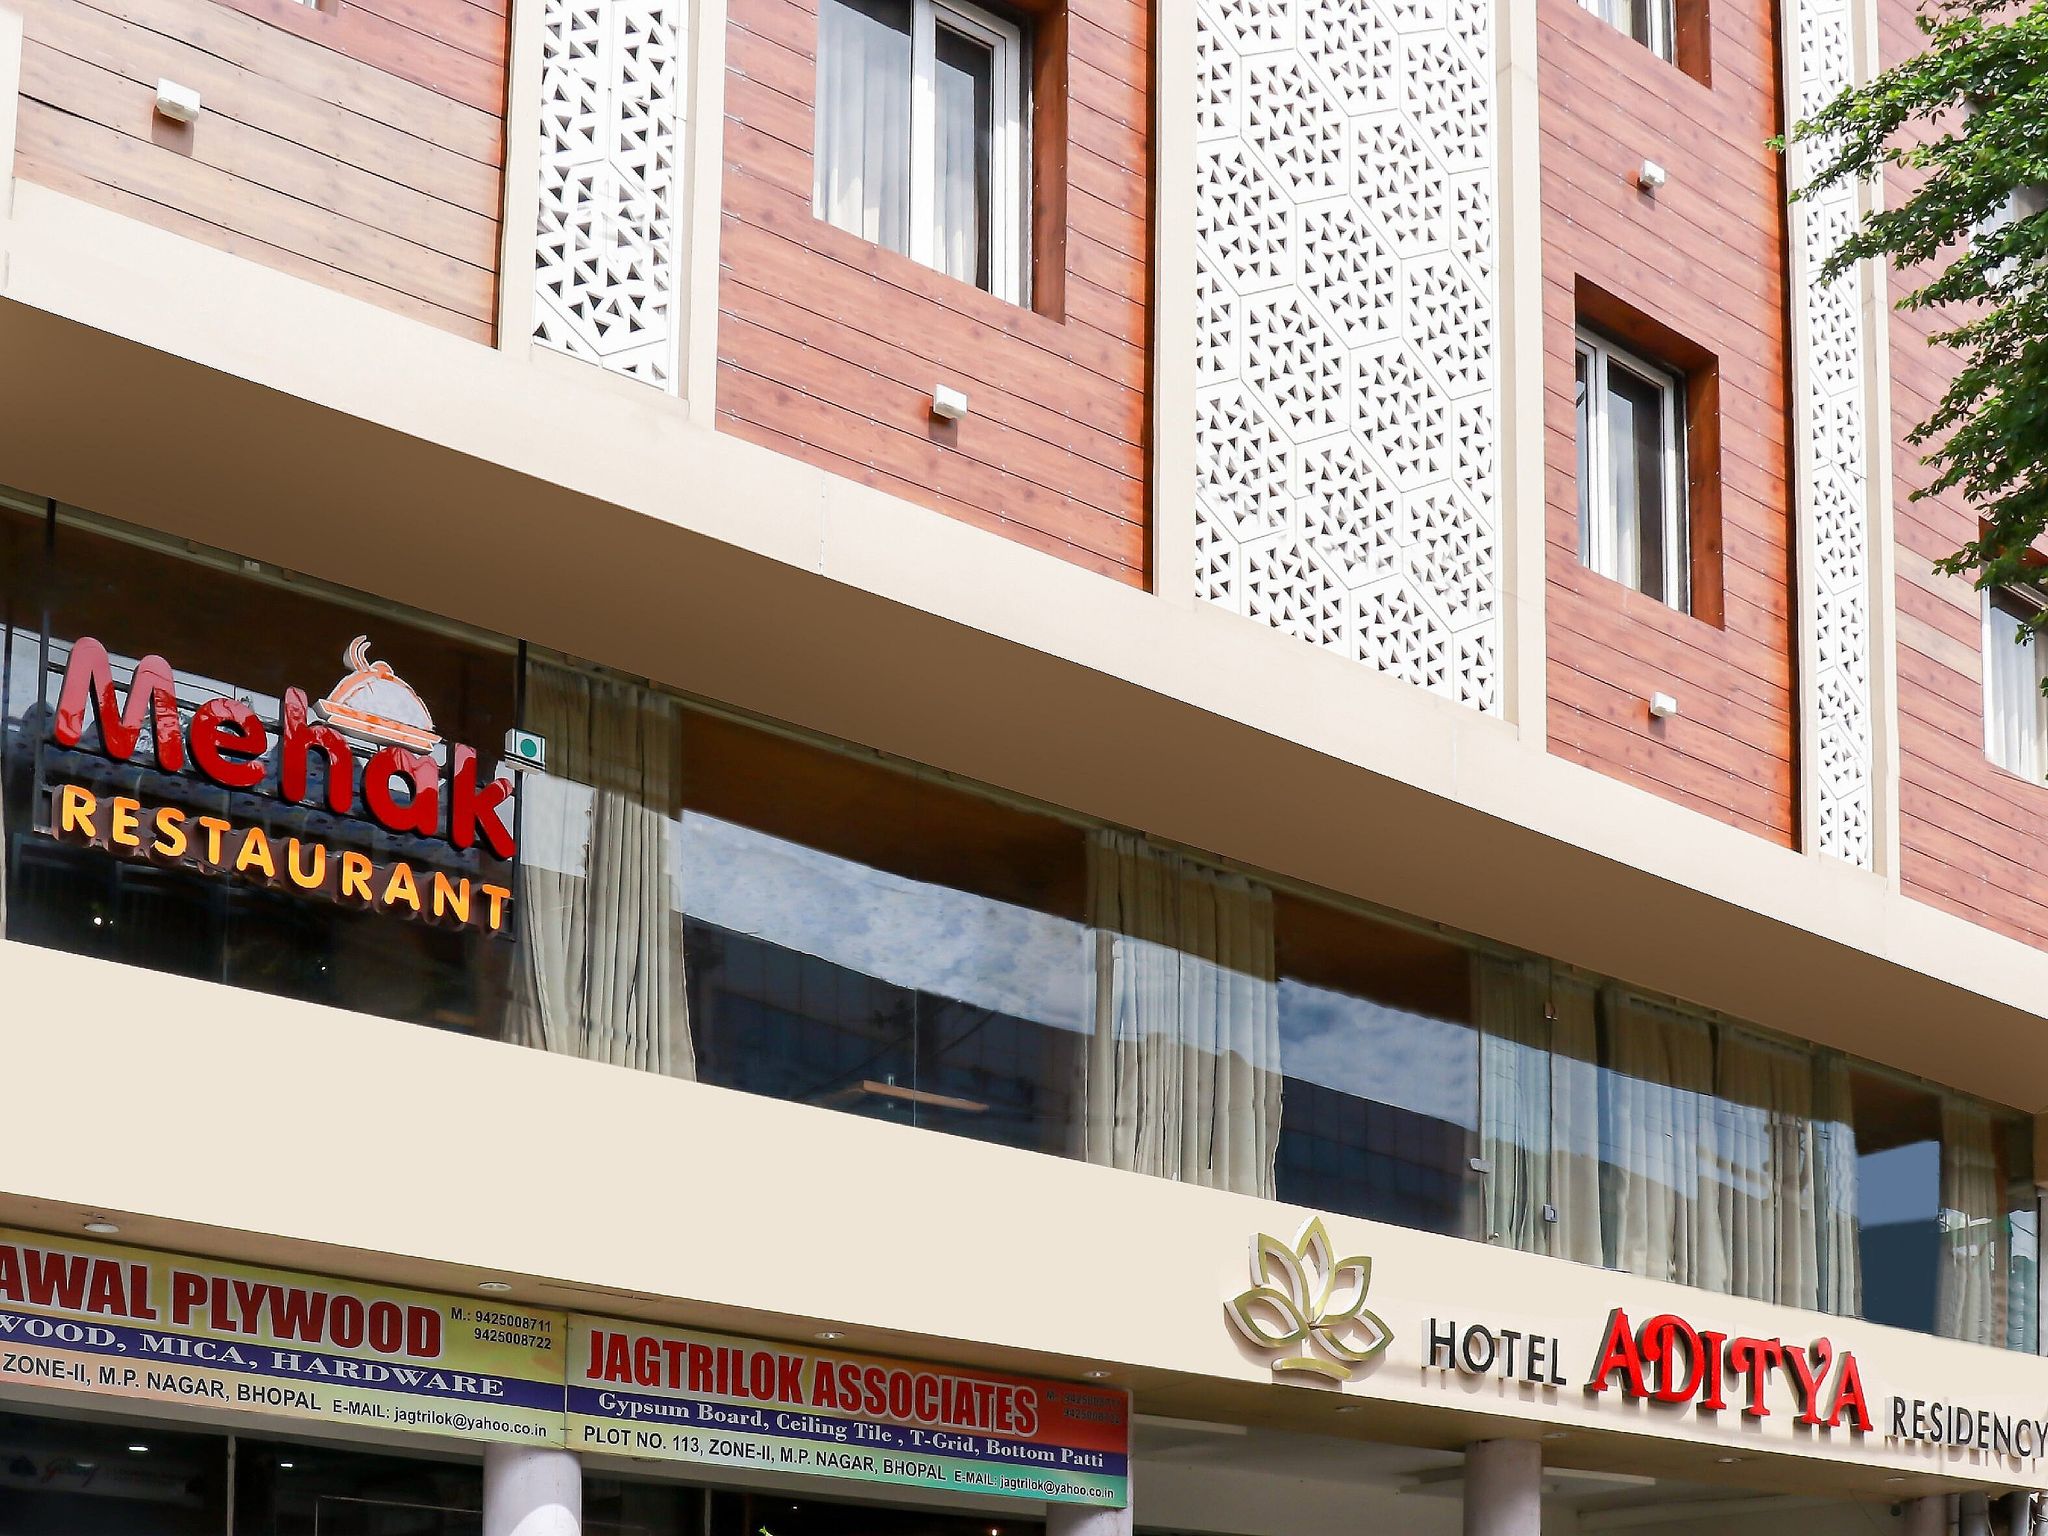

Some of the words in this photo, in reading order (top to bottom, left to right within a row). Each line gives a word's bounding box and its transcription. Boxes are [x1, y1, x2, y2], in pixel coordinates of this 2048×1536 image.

[54, 636, 517, 860] Mehak
[60, 783, 511, 931] RESTAURANT
[173, 1271, 442, 1358] PLYWOOD
[474, 1327, 552, 1350] 9425008722
[475, 1310, 552, 1333] 9425008711
[3, 1353, 91, 1386] ZONE-II,
[100, 1366, 139, 1388] M.P.
[147, 1372, 229, 1402] NAGAR,
[237, 1383, 321, 1411] BHOPAL
[333, 1400, 390, 1418] E-MAIL:
[394, 1406, 547, 1438] jagtrilok@yahoo.co.in
[140, 1333, 258, 1370] MICA,
[270, 1351, 504, 1397] HARDWARE
[587, 1330, 805, 1405] JAGTRILOK
[812, 1361, 1037, 1434] ASSOCIATES
[1428, 1316, 1567, 1386] HOTEL
[1591, 1306, 1874, 1432] ADITYA
[1892, 1395, 2048, 1458] RESIDENCY
[584, 1425, 631, 1446] PLOT
[636, 1431, 666, 1450] NO.
[673, 1435, 704, 1457] 113,
[709, 1438, 775, 1464] ZONE-II,
[780, 1447, 811, 1466] M.P.
[816, 1452, 878, 1474] NAGAR,
[883, 1459, 947, 1481] BHOPAL
[954, 1470, 997, 1486] E-MAIL:
[1000, 1475, 1114, 1499] jagtrilok@yahoo.co.in
[599, 1392, 690, 1419] Gypsum
[697, 1403, 769, 1430] Board,
[776, 1413, 848, 1442] Ceiling
[853, 1422, 892, 1442] Tile
[910, 1428, 980, 1456] T-Grid,
[986, 1438, 1055, 1462] Bottom
[1060, 1447, 1104, 1468] Patti
